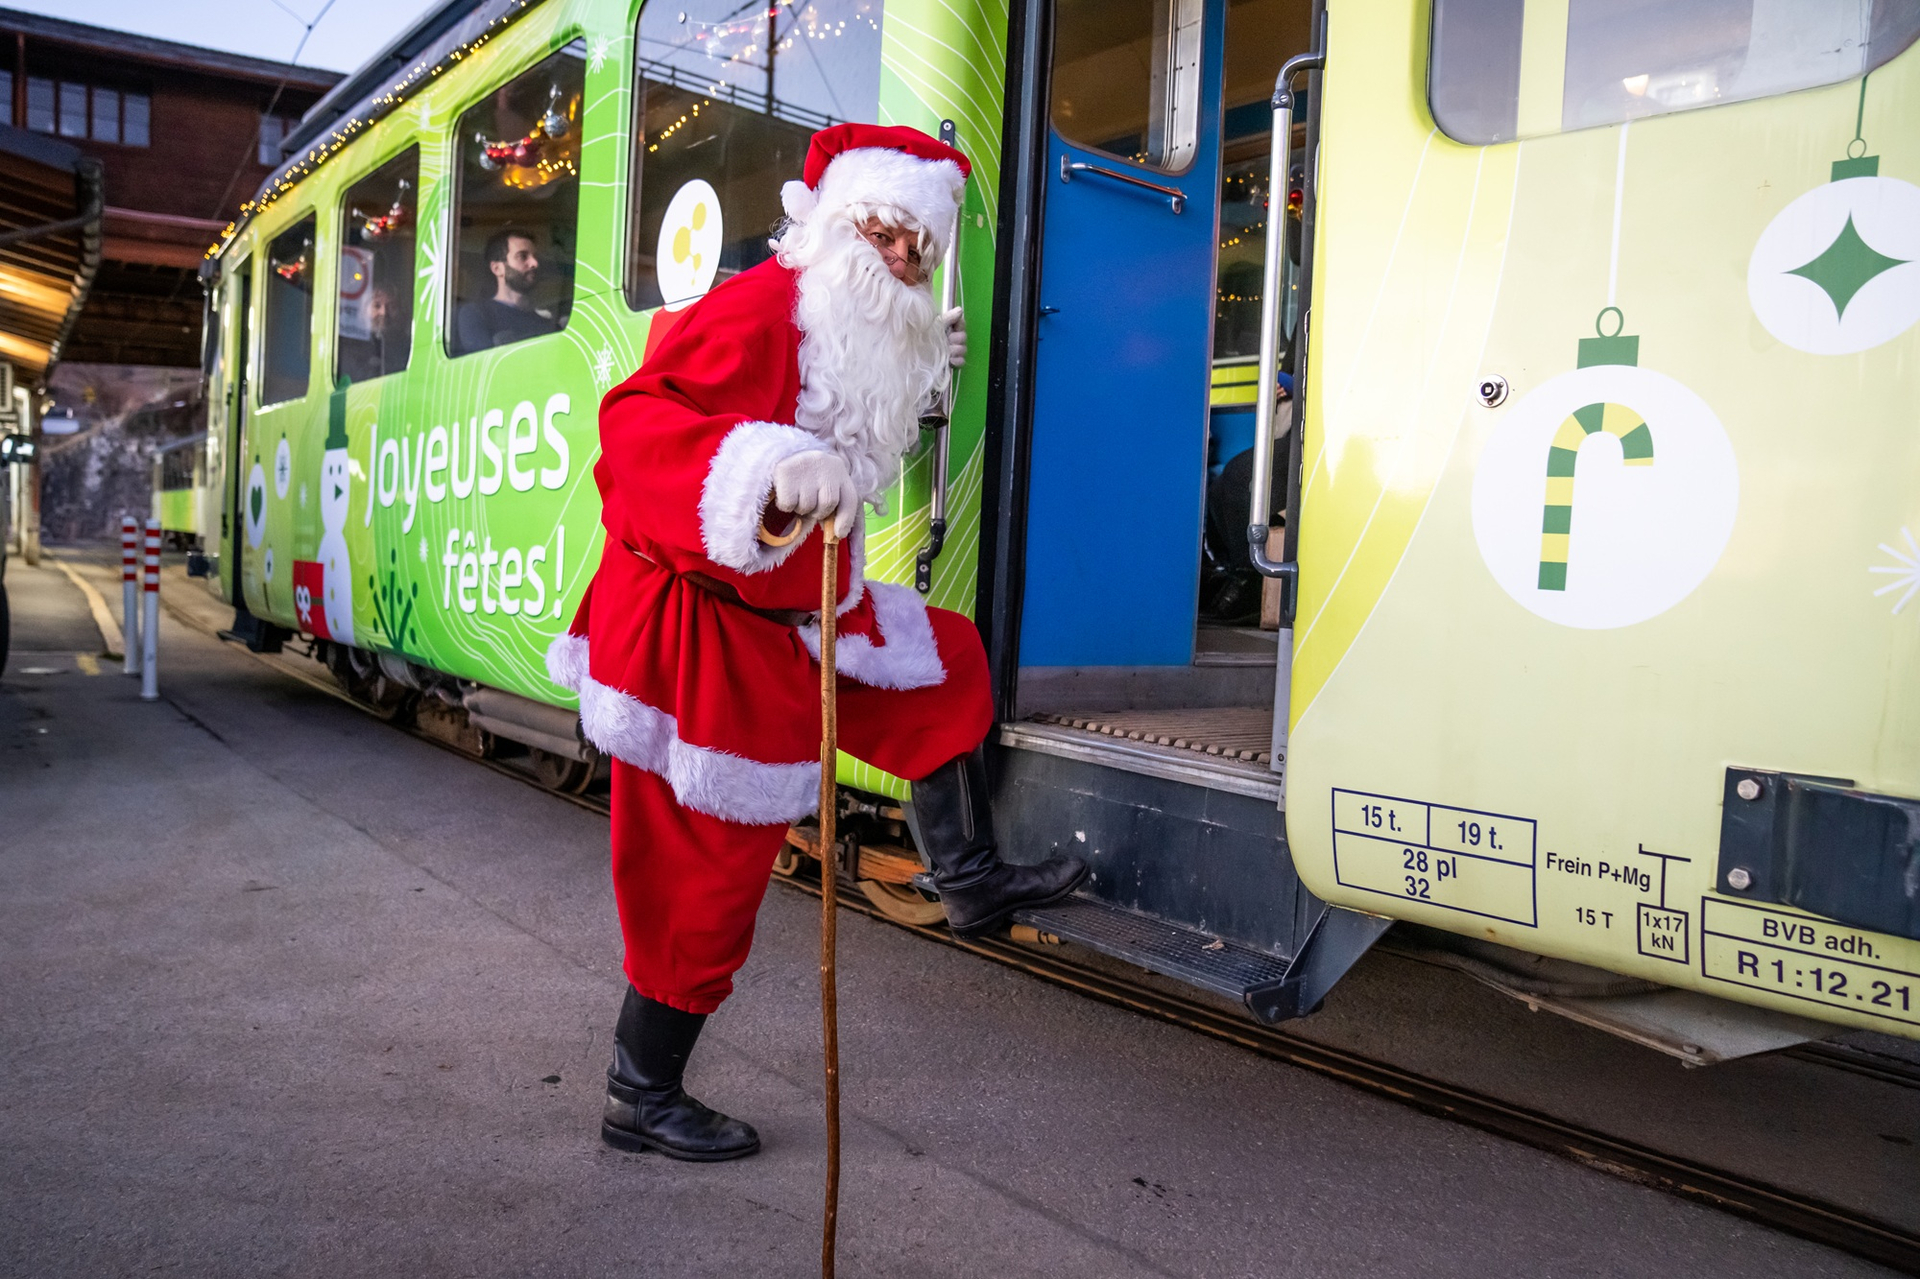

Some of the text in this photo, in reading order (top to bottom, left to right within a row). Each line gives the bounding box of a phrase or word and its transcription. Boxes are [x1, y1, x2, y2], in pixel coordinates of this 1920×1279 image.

[1361, 804, 1402, 833] 15 t.
[1458, 820, 1503, 850] 19 t.
[1402, 848, 1457, 882] 28 pl
[1547, 852, 1651, 893] Frein P+Mg
[1405, 875, 1431, 900] 32
[1576, 907, 1613, 929] 15 T
[1643, 911, 1683, 932] 1x17
[1652, 932, 1674, 951] kN
[1763, 917, 1881, 960] BVB adh.
